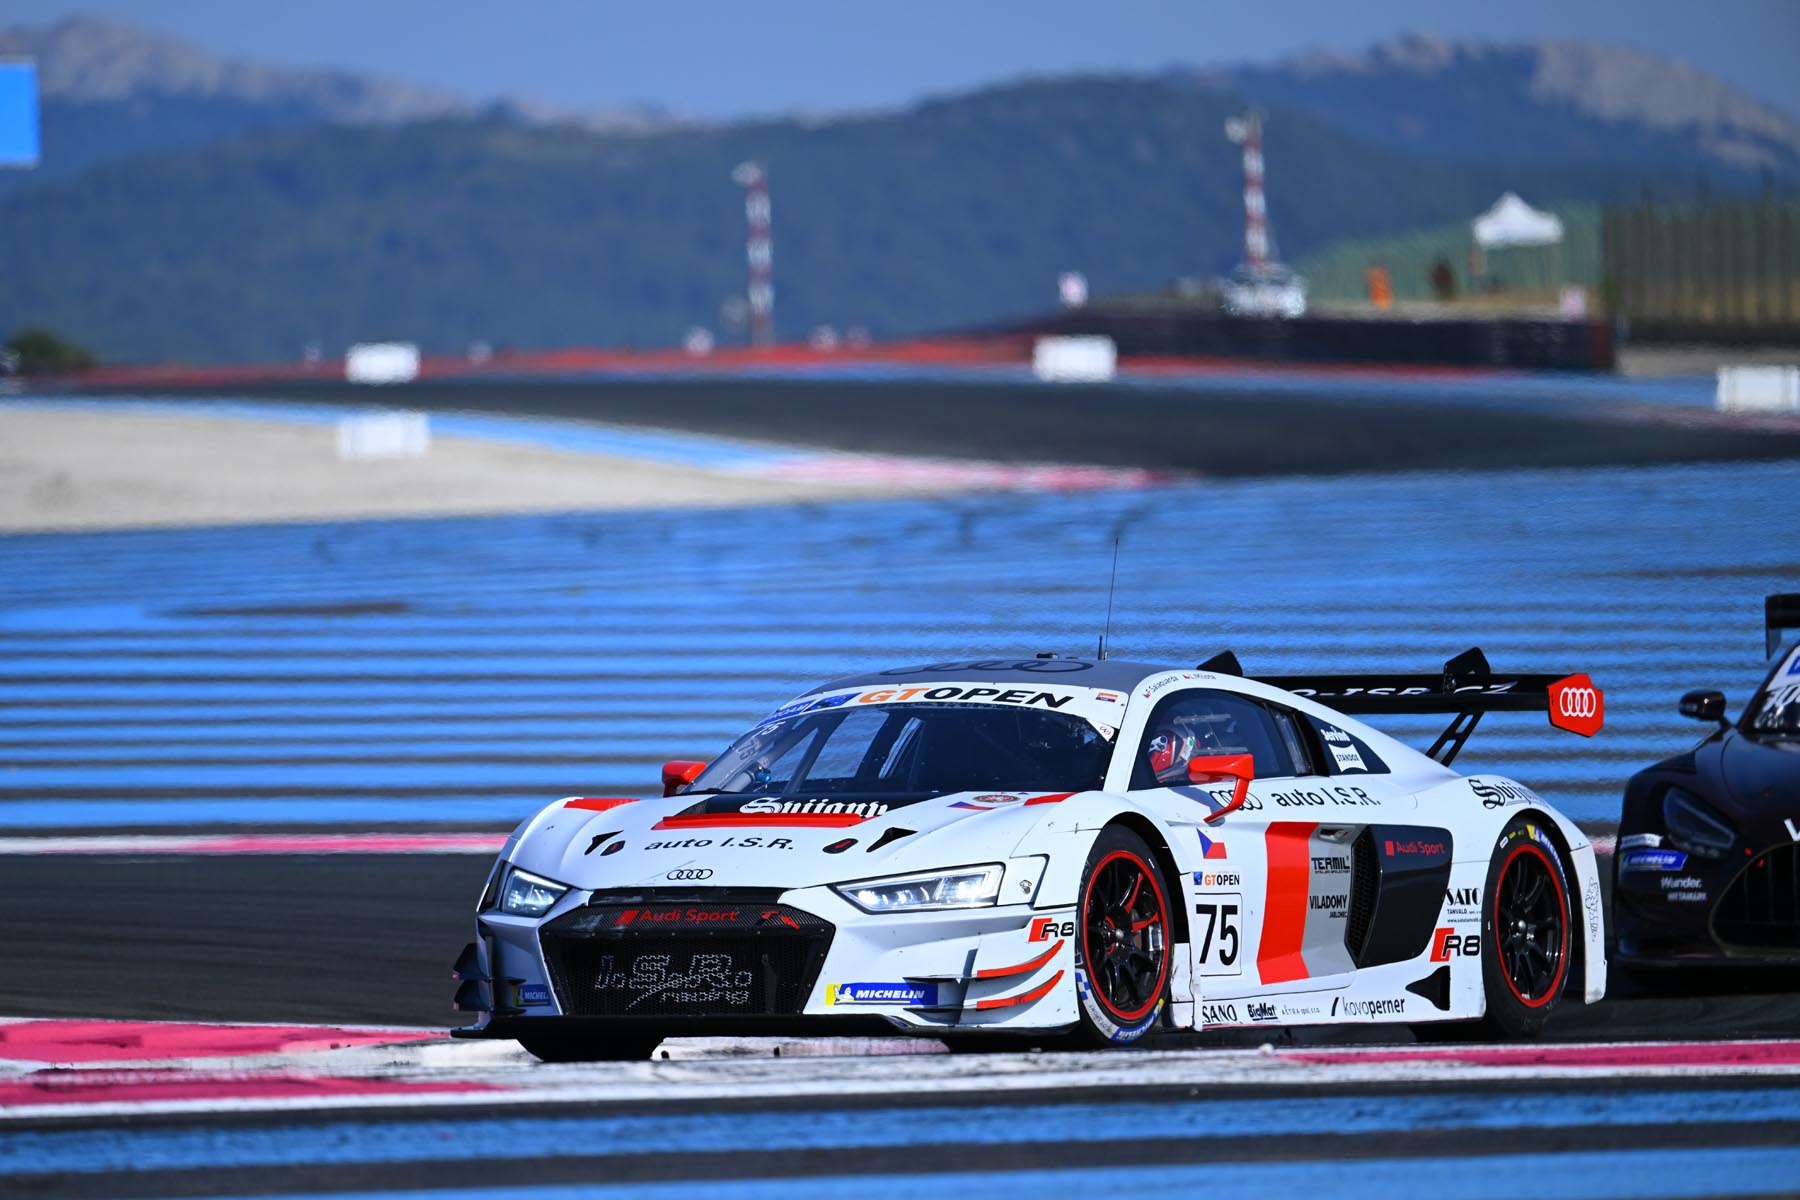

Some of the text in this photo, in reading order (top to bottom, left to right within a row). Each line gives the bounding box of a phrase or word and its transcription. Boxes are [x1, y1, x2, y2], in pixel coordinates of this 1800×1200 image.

[1271, 787, 1381, 807] auto I.S.R.
[644, 838, 794, 850] auto I.S.R.
[1396, 841, 1445, 857] Audi Sport
[1309, 895, 1348, 909] VILADOMY
[1446, 888, 1482, 906] SATO
[639, 908, 740, 925] Audi Sport
[1041, 922, 1075, 938] R8
[1196, 904, 1239, 966] 75
[1442, 935, 1481, 957] R8
[855, 989, 926, 999] MICHELIN
[1247, 1002, 1277, 1020] BigMat
[1342, 997, 1406, 1019] kovoperner
